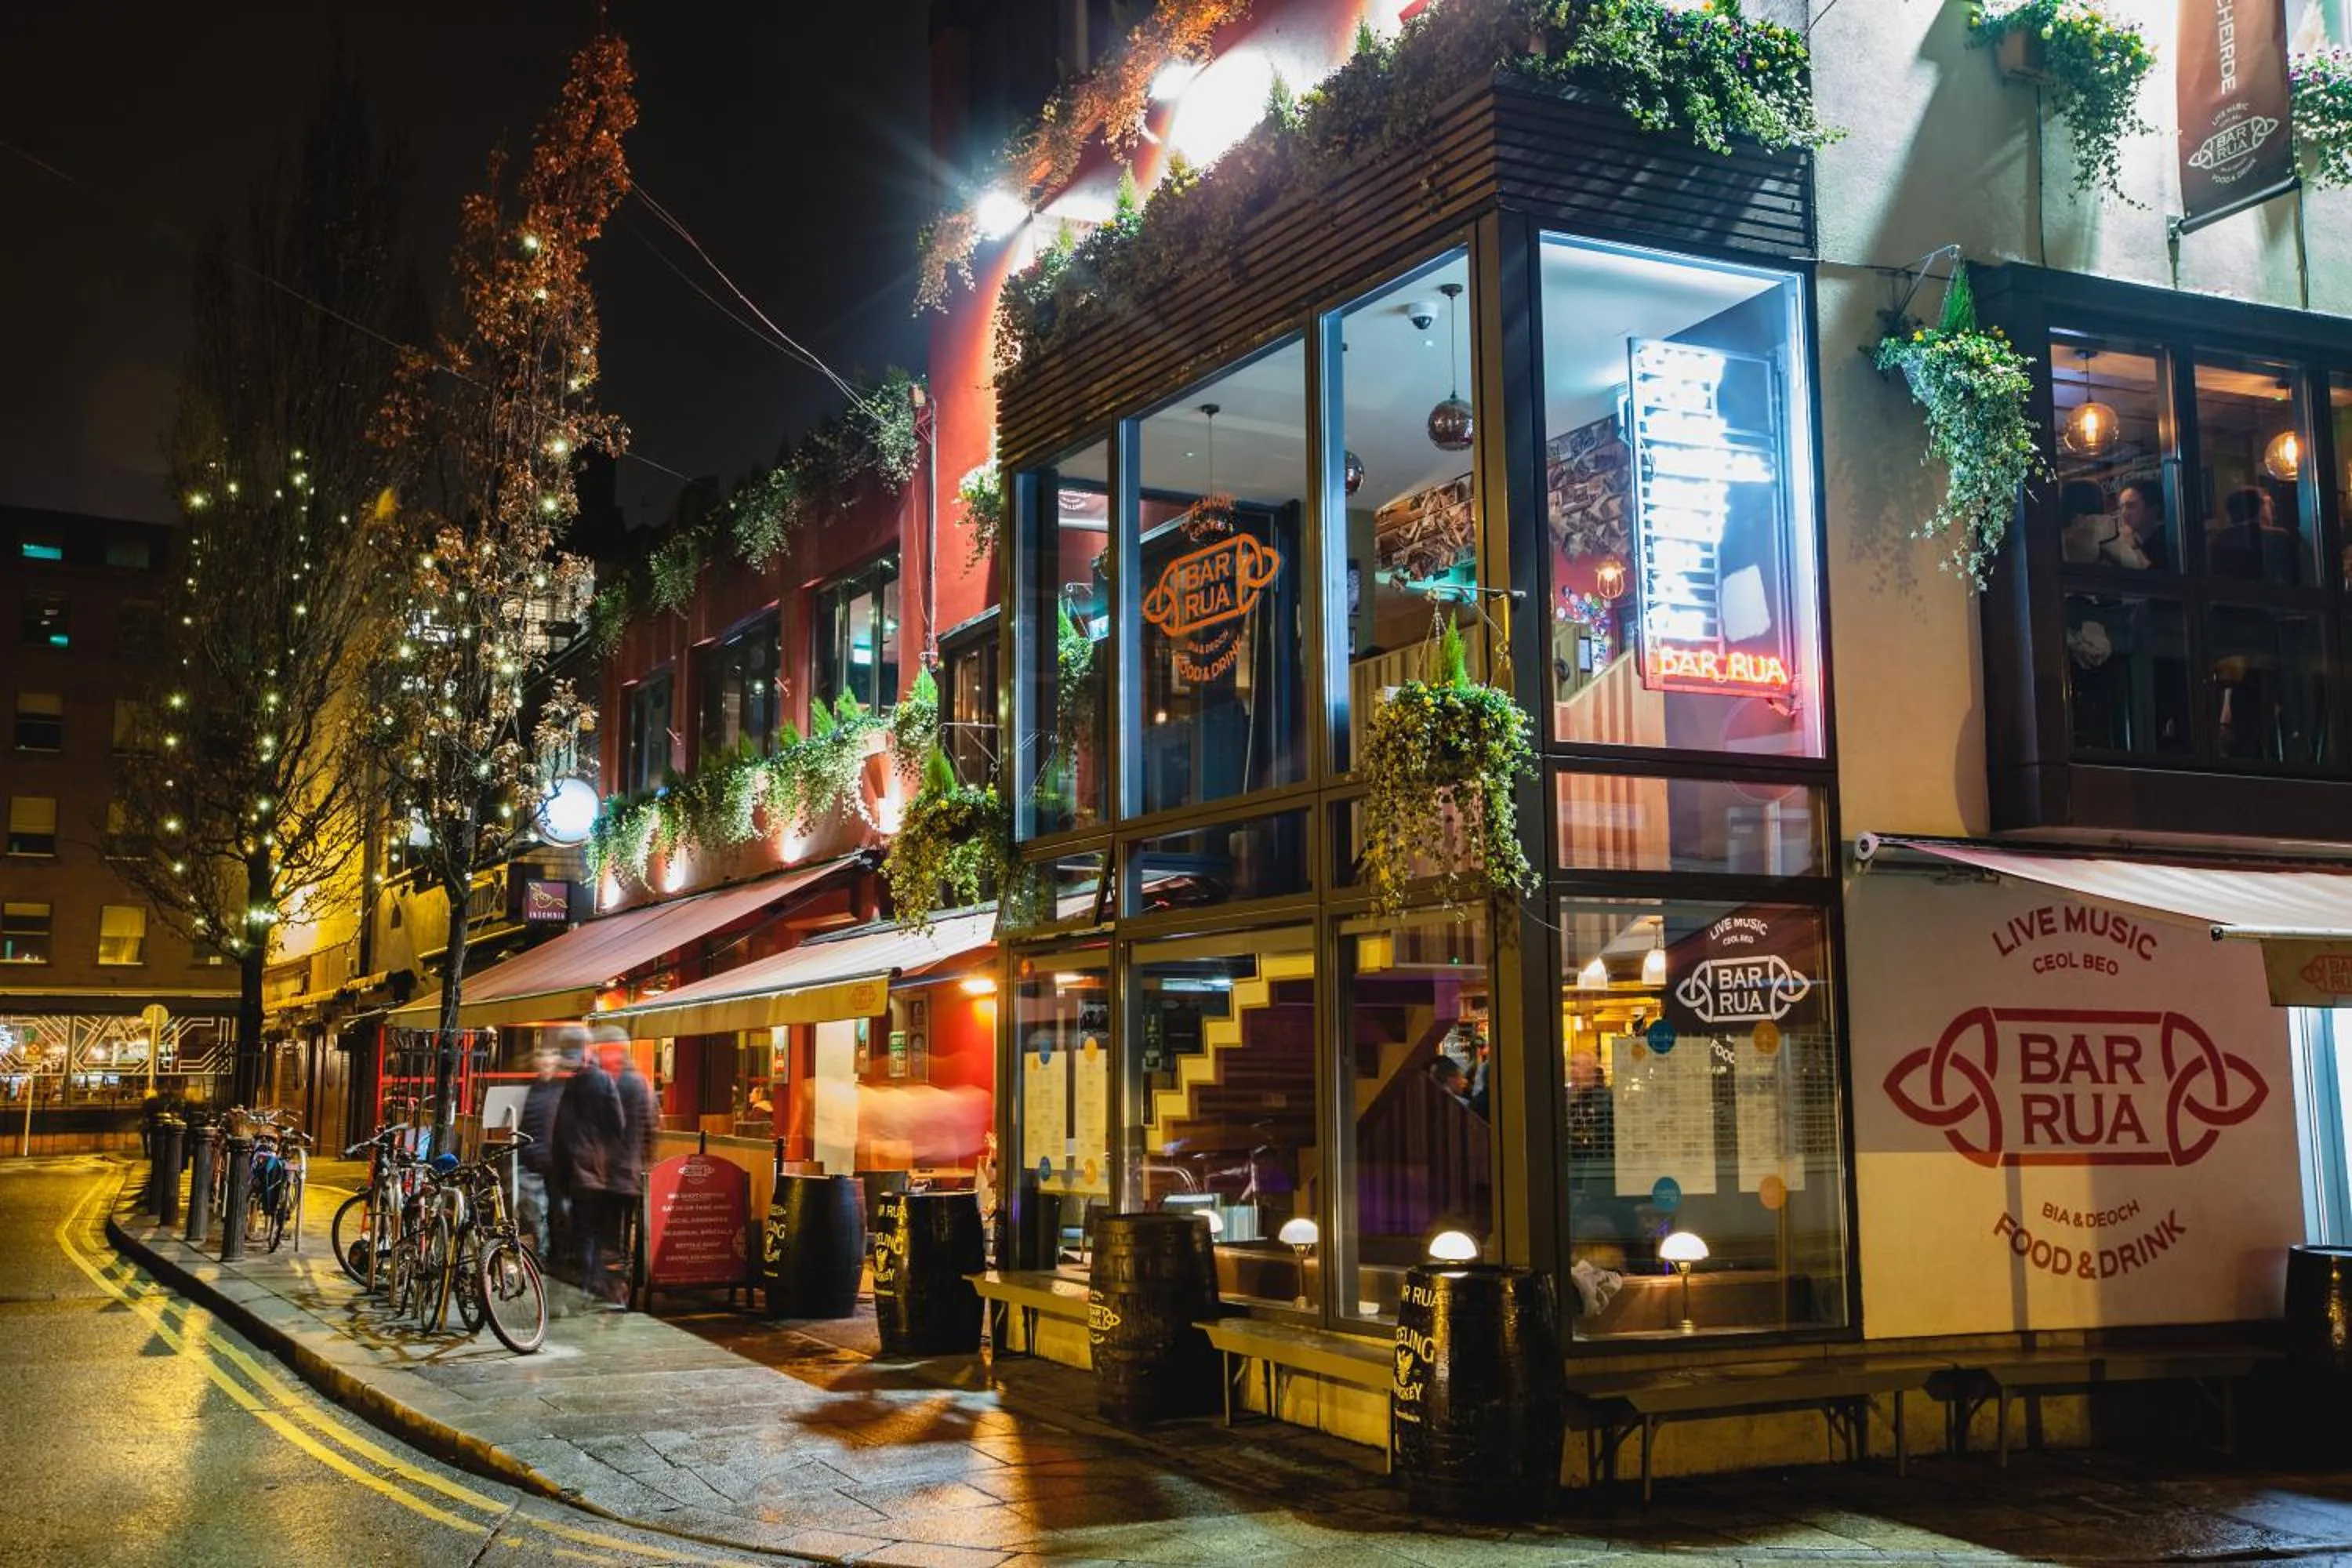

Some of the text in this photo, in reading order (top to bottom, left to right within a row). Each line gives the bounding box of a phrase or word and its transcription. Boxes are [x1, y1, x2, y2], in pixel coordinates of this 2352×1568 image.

[2217, 126, 2246, 147] BAR
[2217, 140, 2248, 159] RUA
[1185, 552, 1230, 589] BAR
[1185, 583, 1231, 620] RUA
[1660, 646, 1788, 684] BAR RUA
[1710, 917, 1768, 940] LIVE MUSIC
[1991, 906, 2158, 960] LIVE MUSIC
[1718, 967, 1762, 990] BAR
[2032, 953, 2118, 976] CEOL BEO
[1719, 990, 1765, 1014] RUA
[2018, 1033, 2145, 1085] BAR
[2020, 1093, 2151, 1145] RUA
[2042, 1202, 2070, 1224] BIA
[2085, 1200, 2140, 1228] DEOCH
[1993, 1209, 2186, 1279] FOOD & DRINK
[1413, 1286, 1441, 1307] RUA
